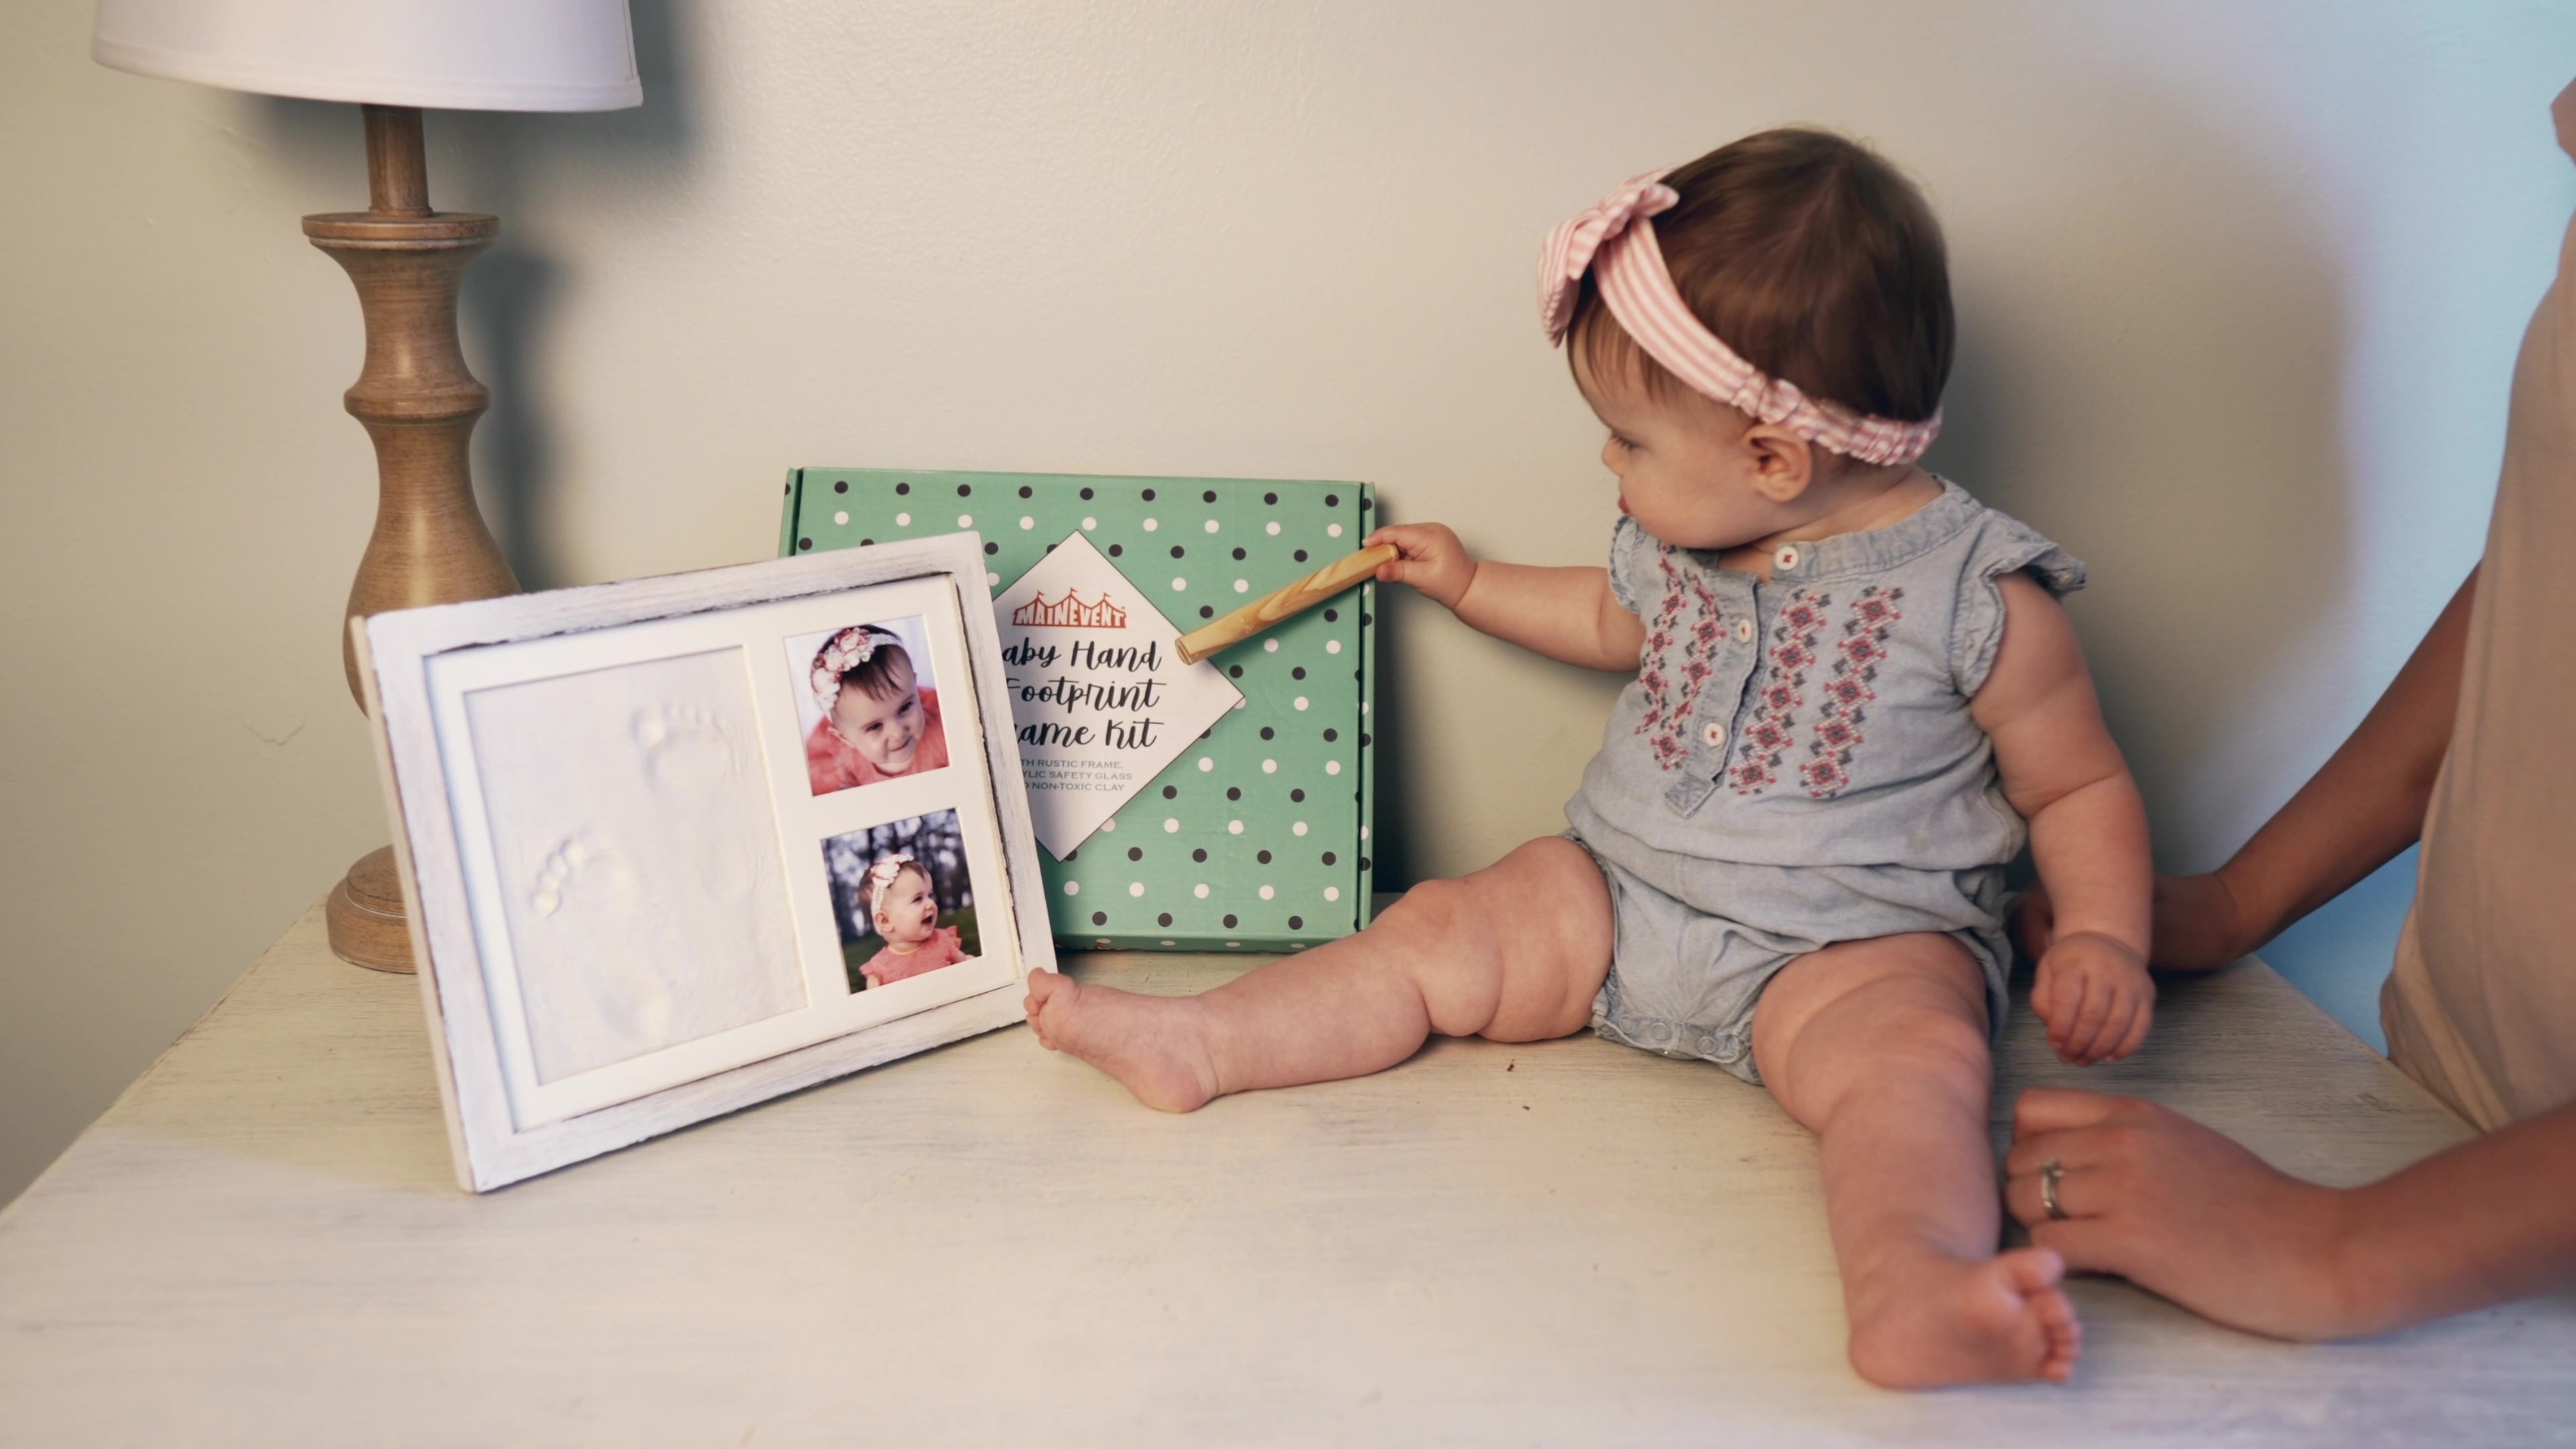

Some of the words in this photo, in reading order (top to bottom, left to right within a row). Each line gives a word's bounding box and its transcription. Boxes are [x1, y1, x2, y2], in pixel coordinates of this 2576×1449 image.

[1014, 595, 1125, 628] MAINEVENT
[1002, 637, 1061, 668] aby
[1071, 641, 1163, 672] Hand
[1014, 722, 1095, 748] ame
[1106, 718, 1165, 749] Kit
[1021, 759, 1034, 767] TH
[1037, 759, 1078, 768] RUSTIC
[1022, 771, 1046, 779] YLIC
[1049, 771, 1093, 780] SAFETY
[1032, 782, 1091, 791] NON-TOXIC
[1095, 784, 1125, 792] CLAY
